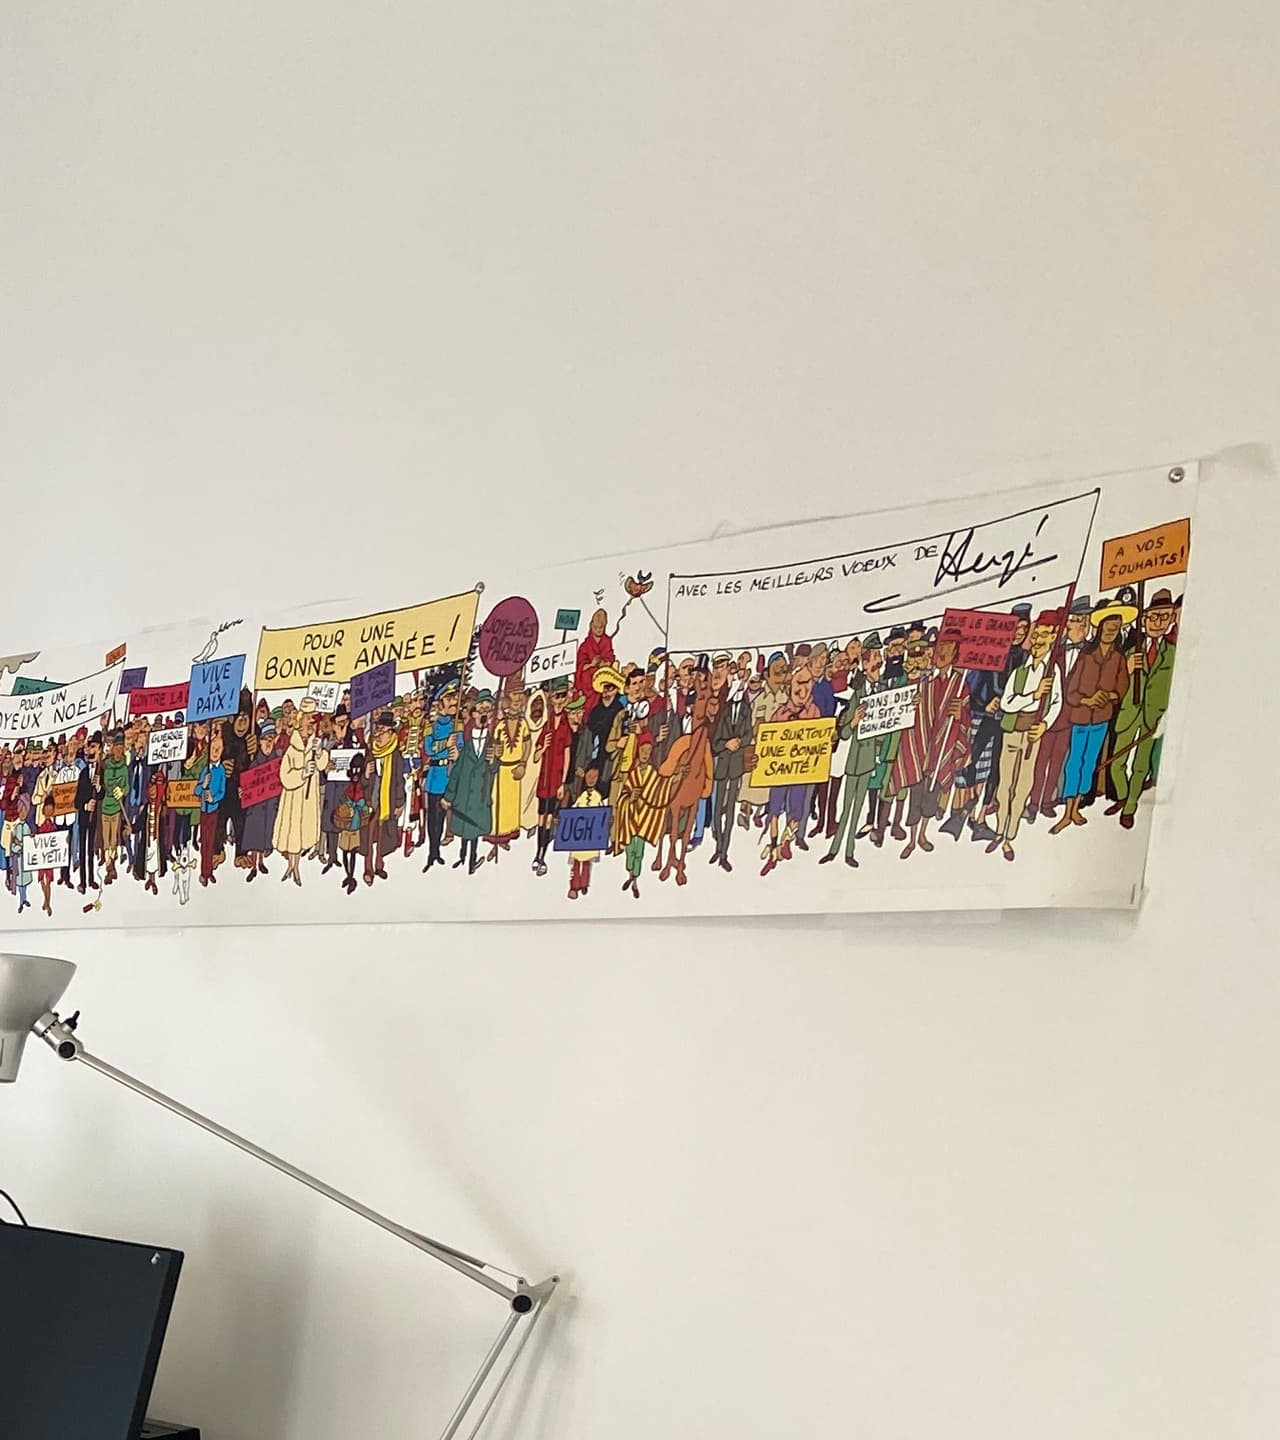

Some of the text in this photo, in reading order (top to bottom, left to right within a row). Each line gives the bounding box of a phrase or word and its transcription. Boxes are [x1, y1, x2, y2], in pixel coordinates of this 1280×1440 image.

[1136, 536, 1166, 553] VOS
[675, 583, 708, 598] AVEC
[716, 581, 742, 595] LES
[750, 567, 834, 592] MEILLEURS
[913, 544, 939, 560] DE
[302, 621, 396, 650] POUR UNE
[264, 654, 337, 681] BONNE
[353, 632, 437, 670] ANNÉE
[202, 663, 231, 684] VIVE
[209, 682, 221, 695] LA
[19, 688, 68, 711] POUR UN
[53, 693, 98, 724] NOËL
[151, 730, 184, 744] GUERRE
[760, 726, 834, 742] ET SURTOUT
[760, 742, 829, 758] UNE BONNE
[33, 836, 58, 849] VIVE
[27, 852, 38, 866] LE
